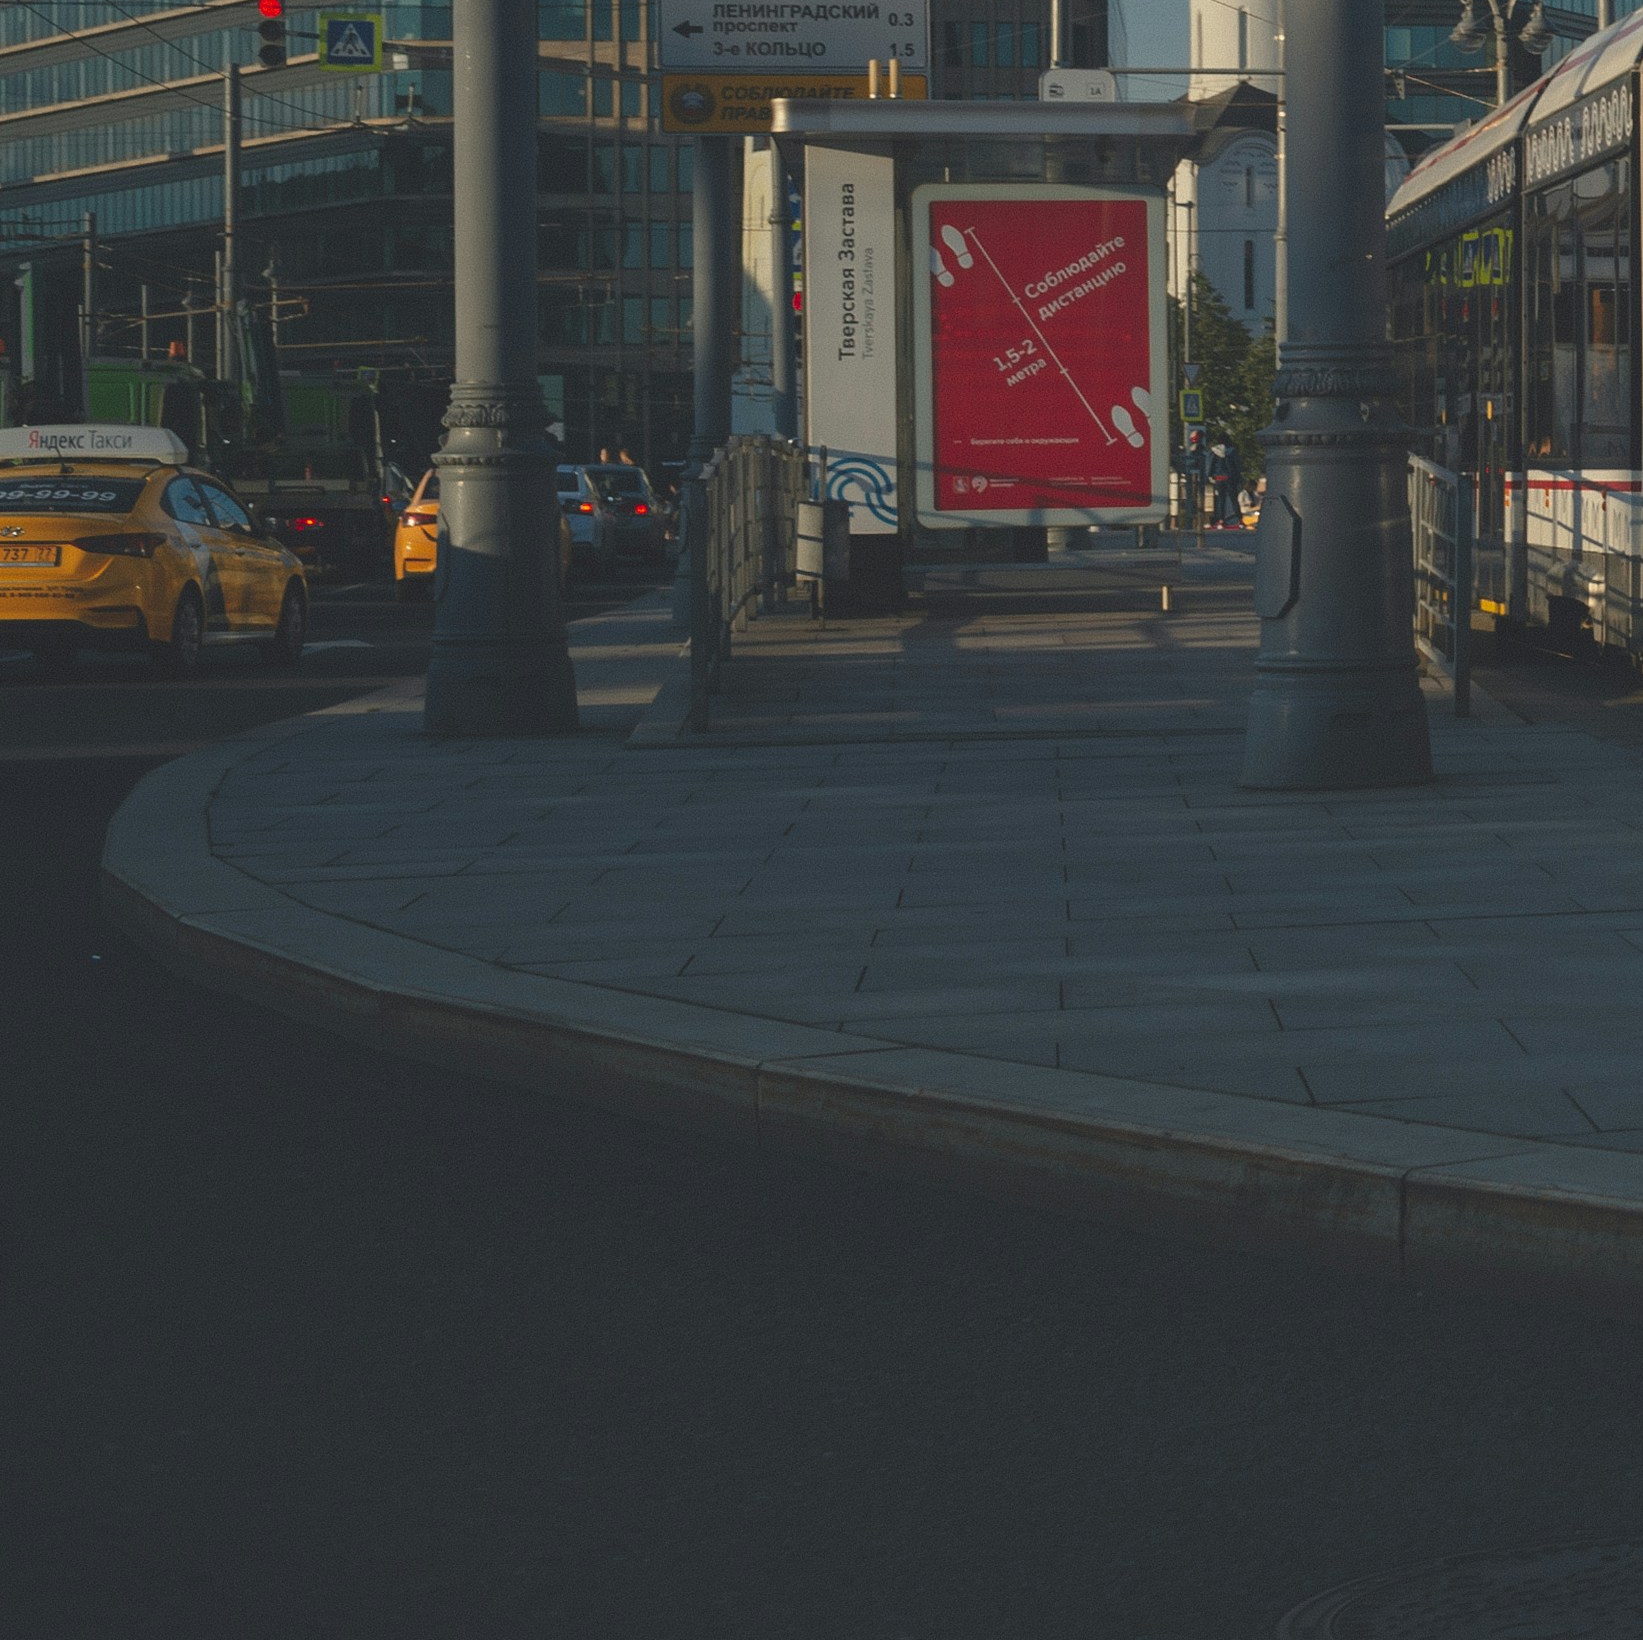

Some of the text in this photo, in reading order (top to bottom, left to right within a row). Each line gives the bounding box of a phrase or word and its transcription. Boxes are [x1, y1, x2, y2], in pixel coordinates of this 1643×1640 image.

[713, 3, 879, 20] ЛЕНИНГРАДСКИЙ
[888, 13, 914, 28] 0.3
[713, 21, 798, 34] проспект
[713, 42, 826, 59] 3-е КОЛЬЦО
[890, 43, 915, 58] 1.5
[721, 106, 772, 120] ПРАВ
[838, 183, 859, 361] Тверская Застава
[1025, 236, 1126, 299] Соблюдайте
[1038, 262, 1127, 321] дистанцию
[862, 247, 877, 360] Tverskaya Zastava
[993, 339, 1037, 372] 1,5-2
[1006, 358, 1047, 387] метра
[28, 430, 132, 450] Яндекс Такси
[3, 548, 29, 561] 737
